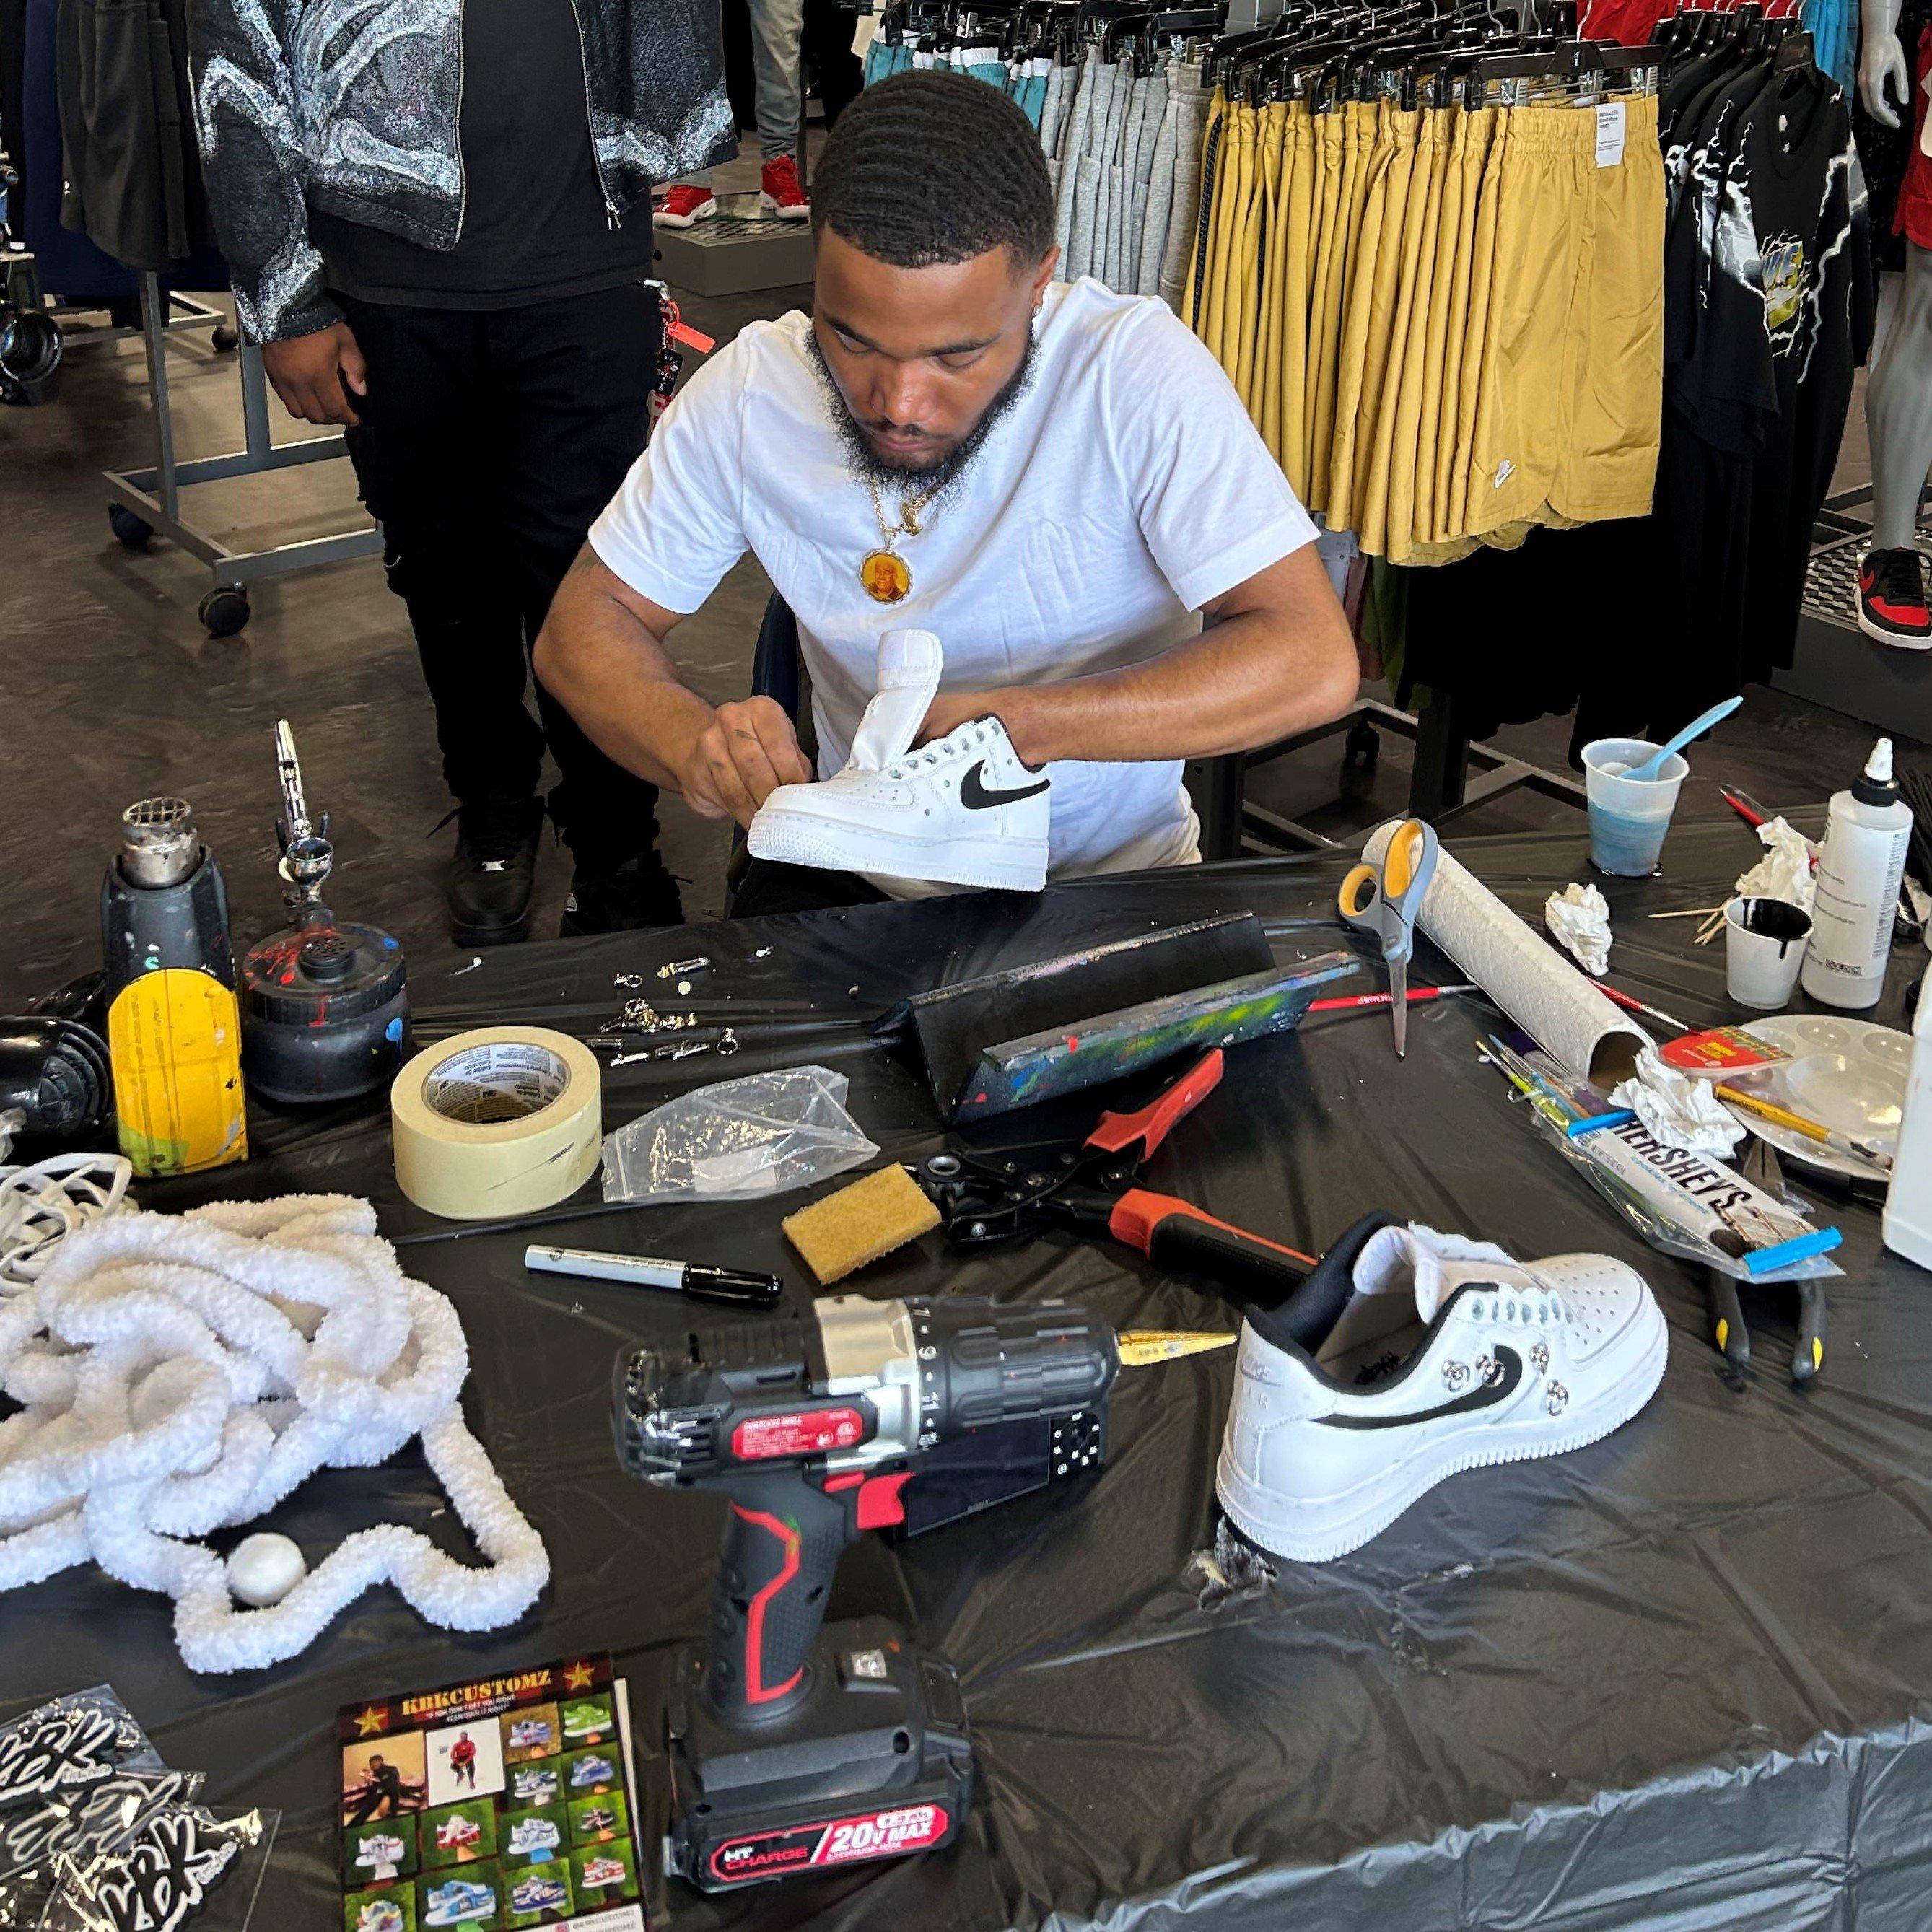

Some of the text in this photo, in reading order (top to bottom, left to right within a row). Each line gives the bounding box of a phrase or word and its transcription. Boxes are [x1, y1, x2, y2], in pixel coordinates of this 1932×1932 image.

[1612, 1119, 1752, 1209] HERSHEY'S
[919, 1345, 937, 1360] 9
[401, 1669, 551, 1715] KBKCUSTOMZ
[887, 1822, 932, 1843] MAX
[725, 1846, 753, 1862] HT
[725, 1848, 808, 1871] CHARGE
